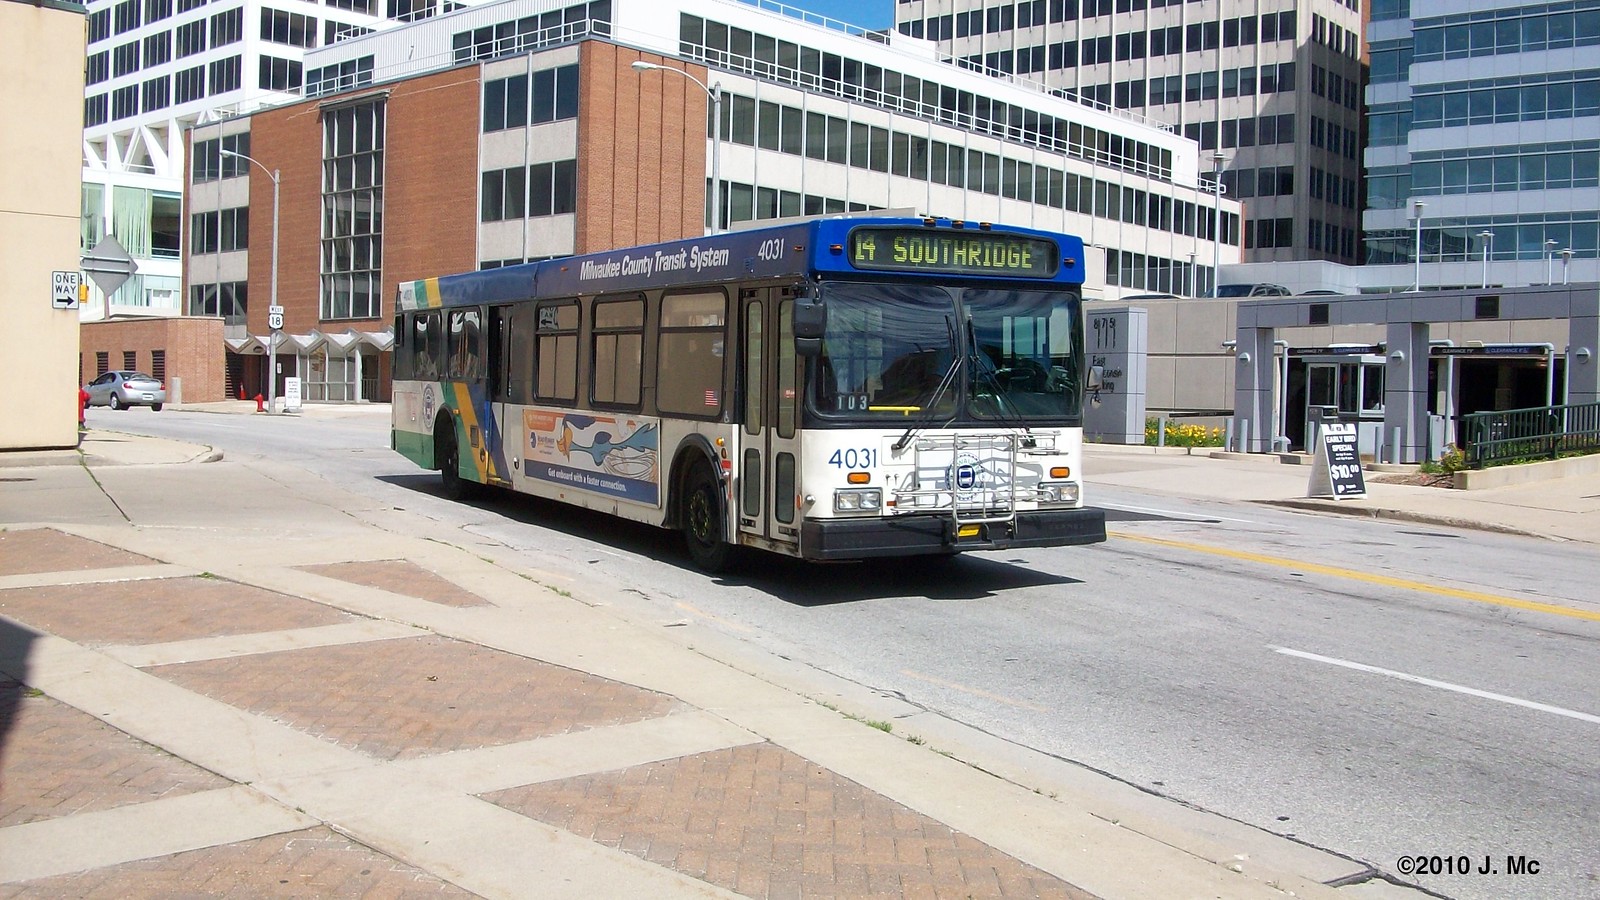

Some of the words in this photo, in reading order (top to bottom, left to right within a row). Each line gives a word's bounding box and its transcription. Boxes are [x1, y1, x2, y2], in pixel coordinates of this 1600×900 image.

[758, 238, 785, 261] 4031
[855, 234, 876, 260] 14
[893, 236, 1032, 268] SOUTHRIDGE
[580, 258, 620, 280] Milwaukee
[622, 254, 653, 277] County
[655, 248, 687, 272] Transit
[689, 246, 729, 272] System
[55, 274, 76, 284] ONE
[55, 285, 77, 294] WAY
[271, 316, 281, 326] 18
[1093, 317, 1116, 329] 875
[838, 395, 868, 410] 103
[1326, 435, 1343, 443] EARLY
[1331, 444, 1354, 452] SPECIAL
[828, 448, 877, 469] 4031
[547, 468, 556, 477] Get
[556, 469, 574, 481] onboard
[573, 472, 583, 483] with
[583, 476, 587, 484] a
[587, 474, 600, 486] faster
[600, 479, 627, 492] connection.
